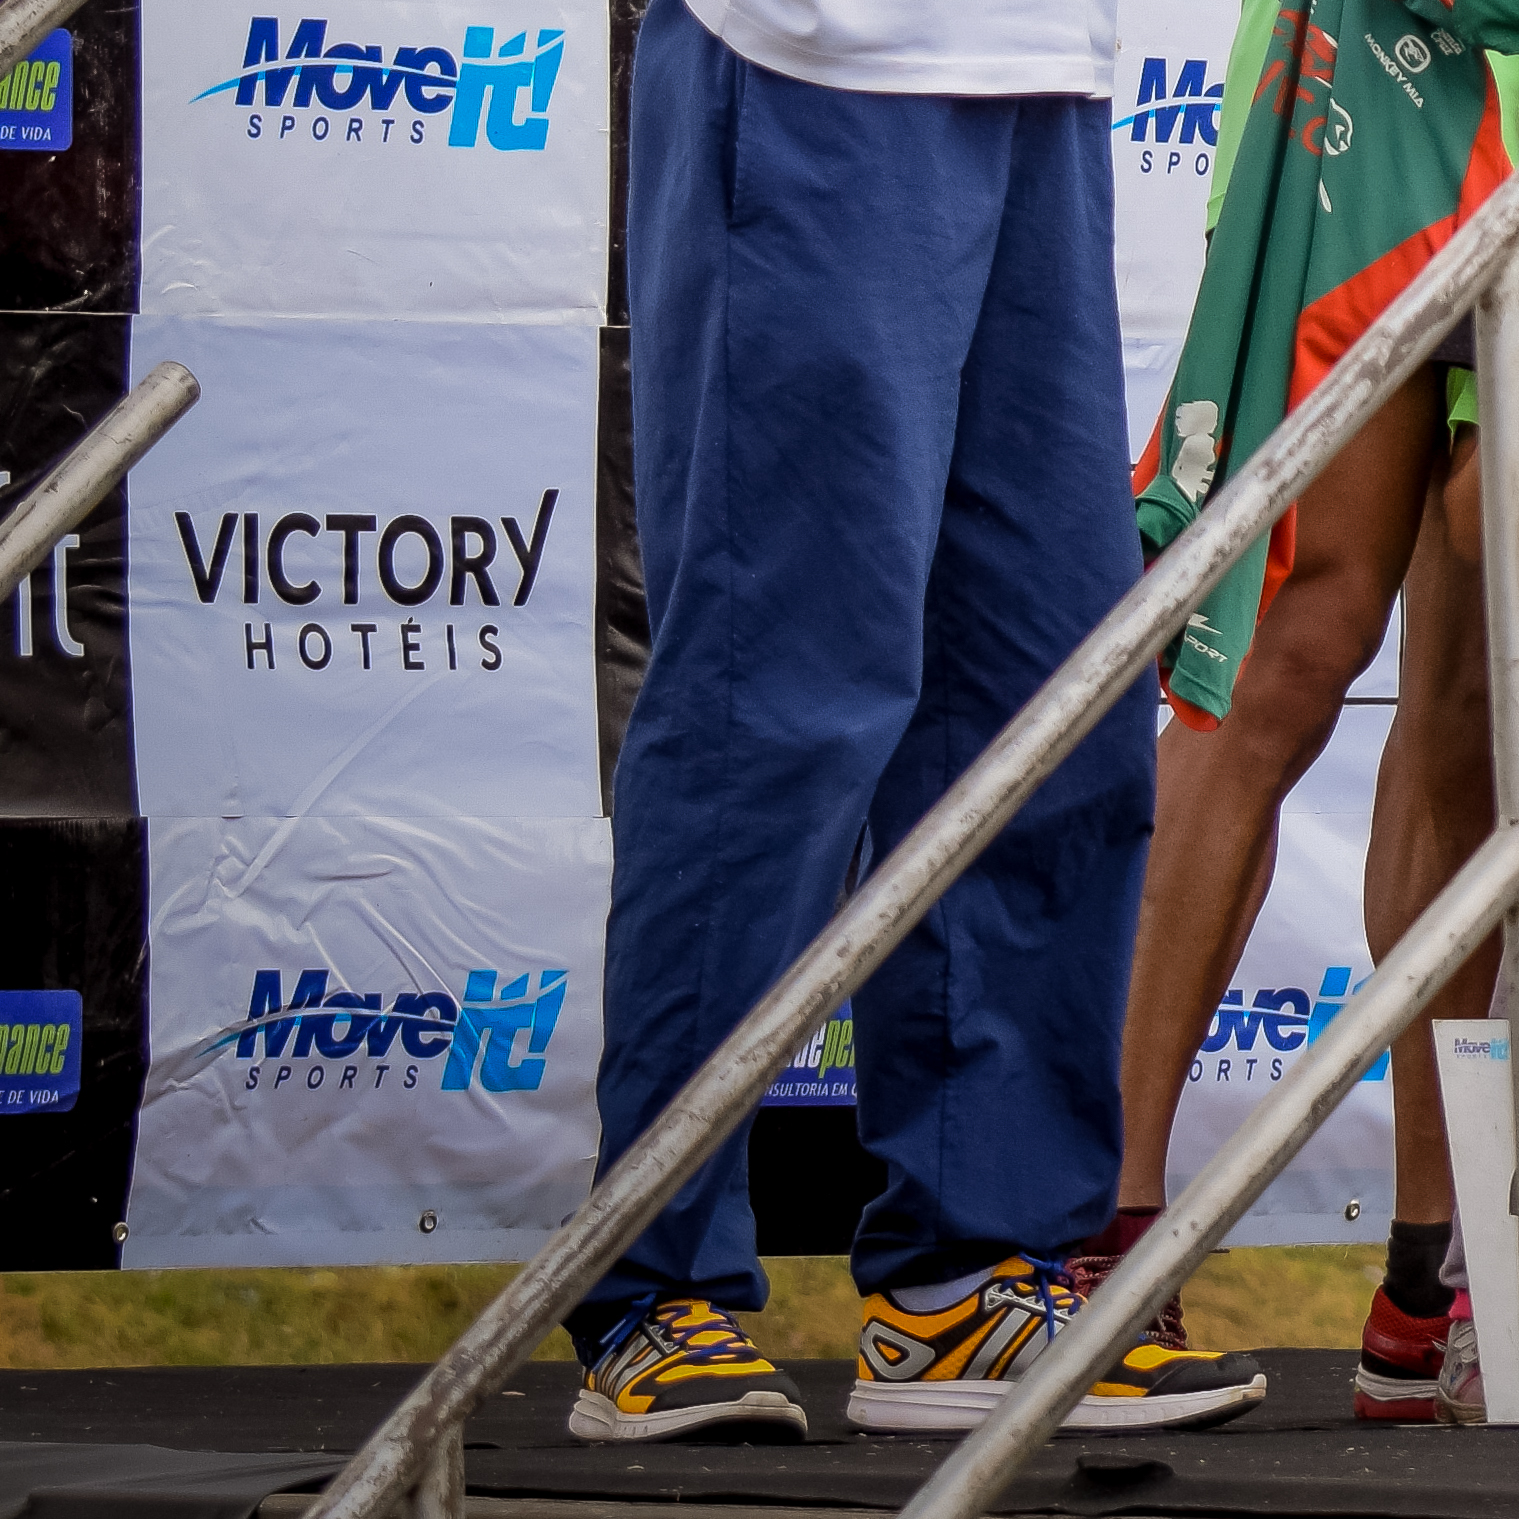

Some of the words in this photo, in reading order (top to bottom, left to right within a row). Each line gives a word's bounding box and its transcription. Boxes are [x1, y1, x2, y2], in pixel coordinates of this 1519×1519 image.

[1364, 32, 1408, 84] MONKEY
[1402, 81, 1425, 108] MIA
[20, 125, 52, 142] VIDA
[247, 116, 425, 144] SPORTS
[1140, 151, 1210, 175] SPO
[175, 488, 560, 607] VICTORY
[245, 617, 504, 672] HOTÉIS
[245, 1066, 419, 1090] SPORTS
[832, 1083, 849, 1096] EM
[30, 1089, 60, 1104] VIDA
